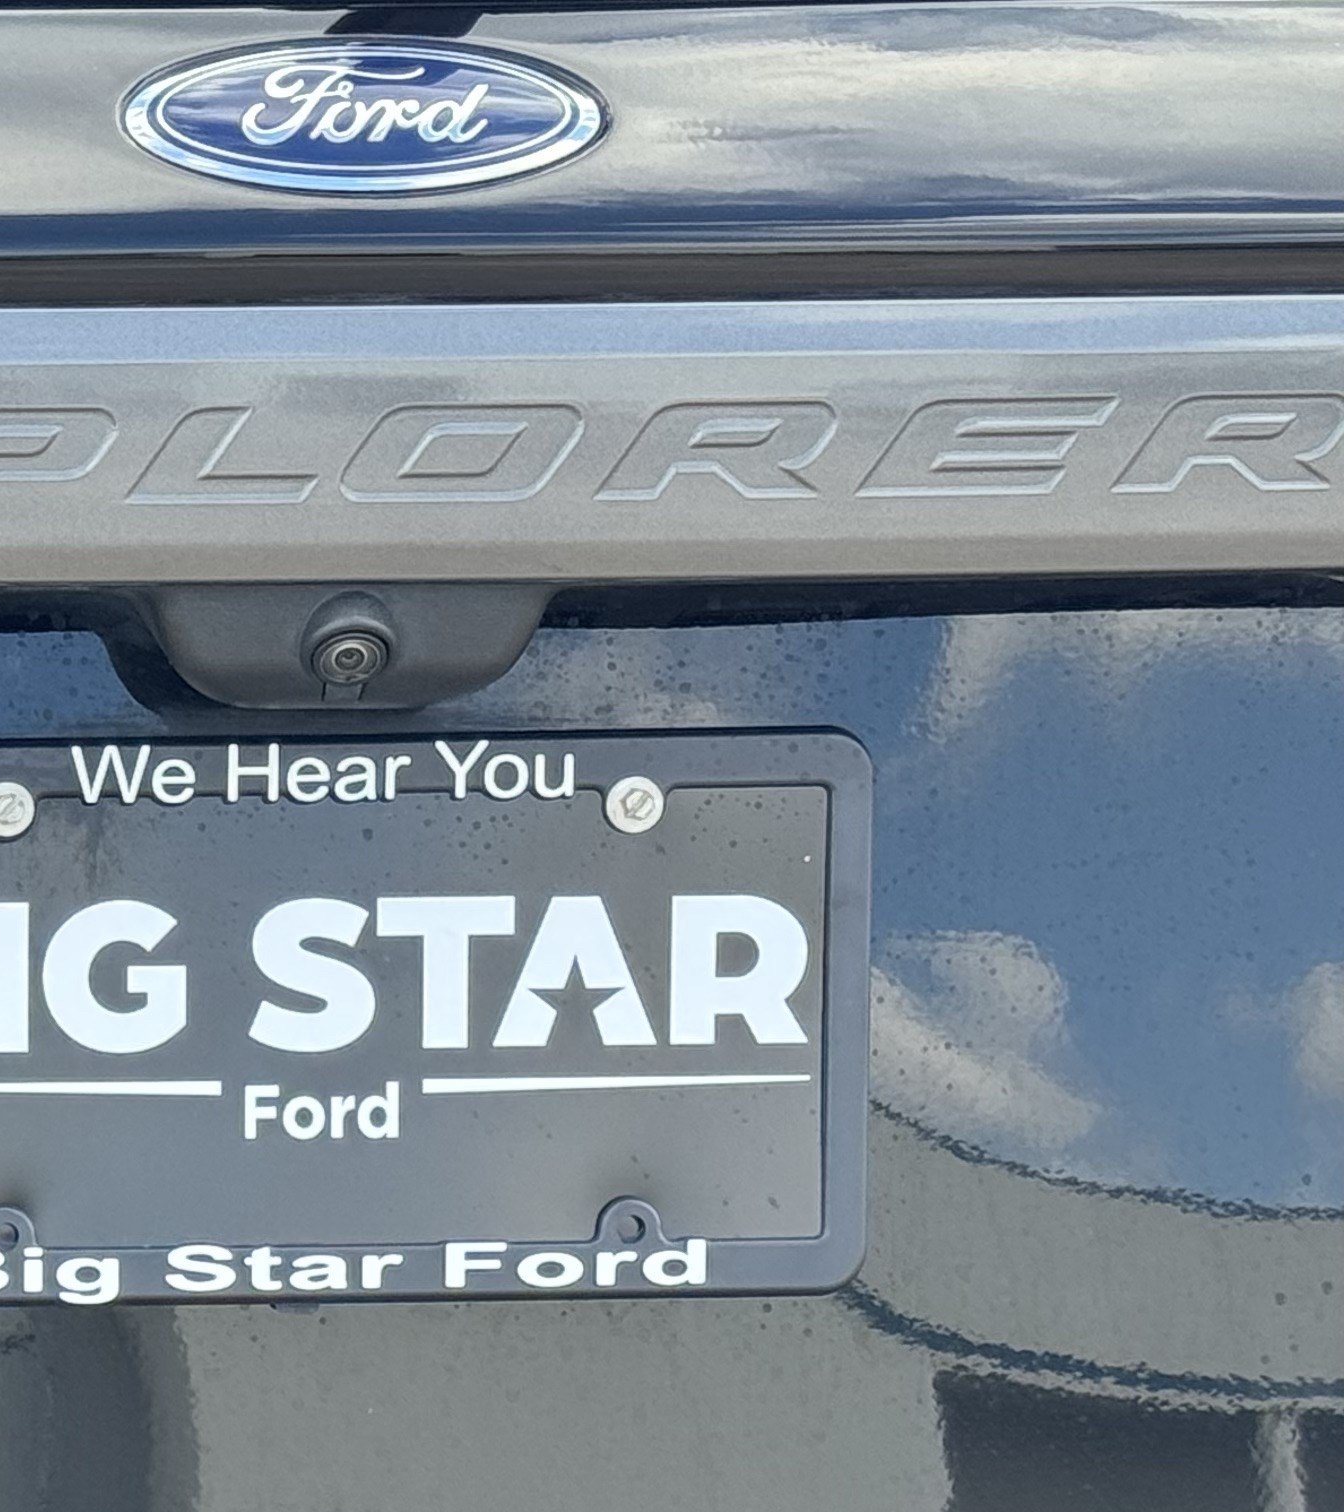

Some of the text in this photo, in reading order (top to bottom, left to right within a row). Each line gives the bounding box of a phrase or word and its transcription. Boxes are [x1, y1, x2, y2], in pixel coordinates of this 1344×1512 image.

[239, 66, 490, 146] Ford
[71, 738, 576, 804] We Hear You
[247, 893, 809, 1054] STAR
[242, 1081, 402, 1140] Ford
[164, 1242, 404, 1294] Star
[440, 1238, 709, 1290] Ford
